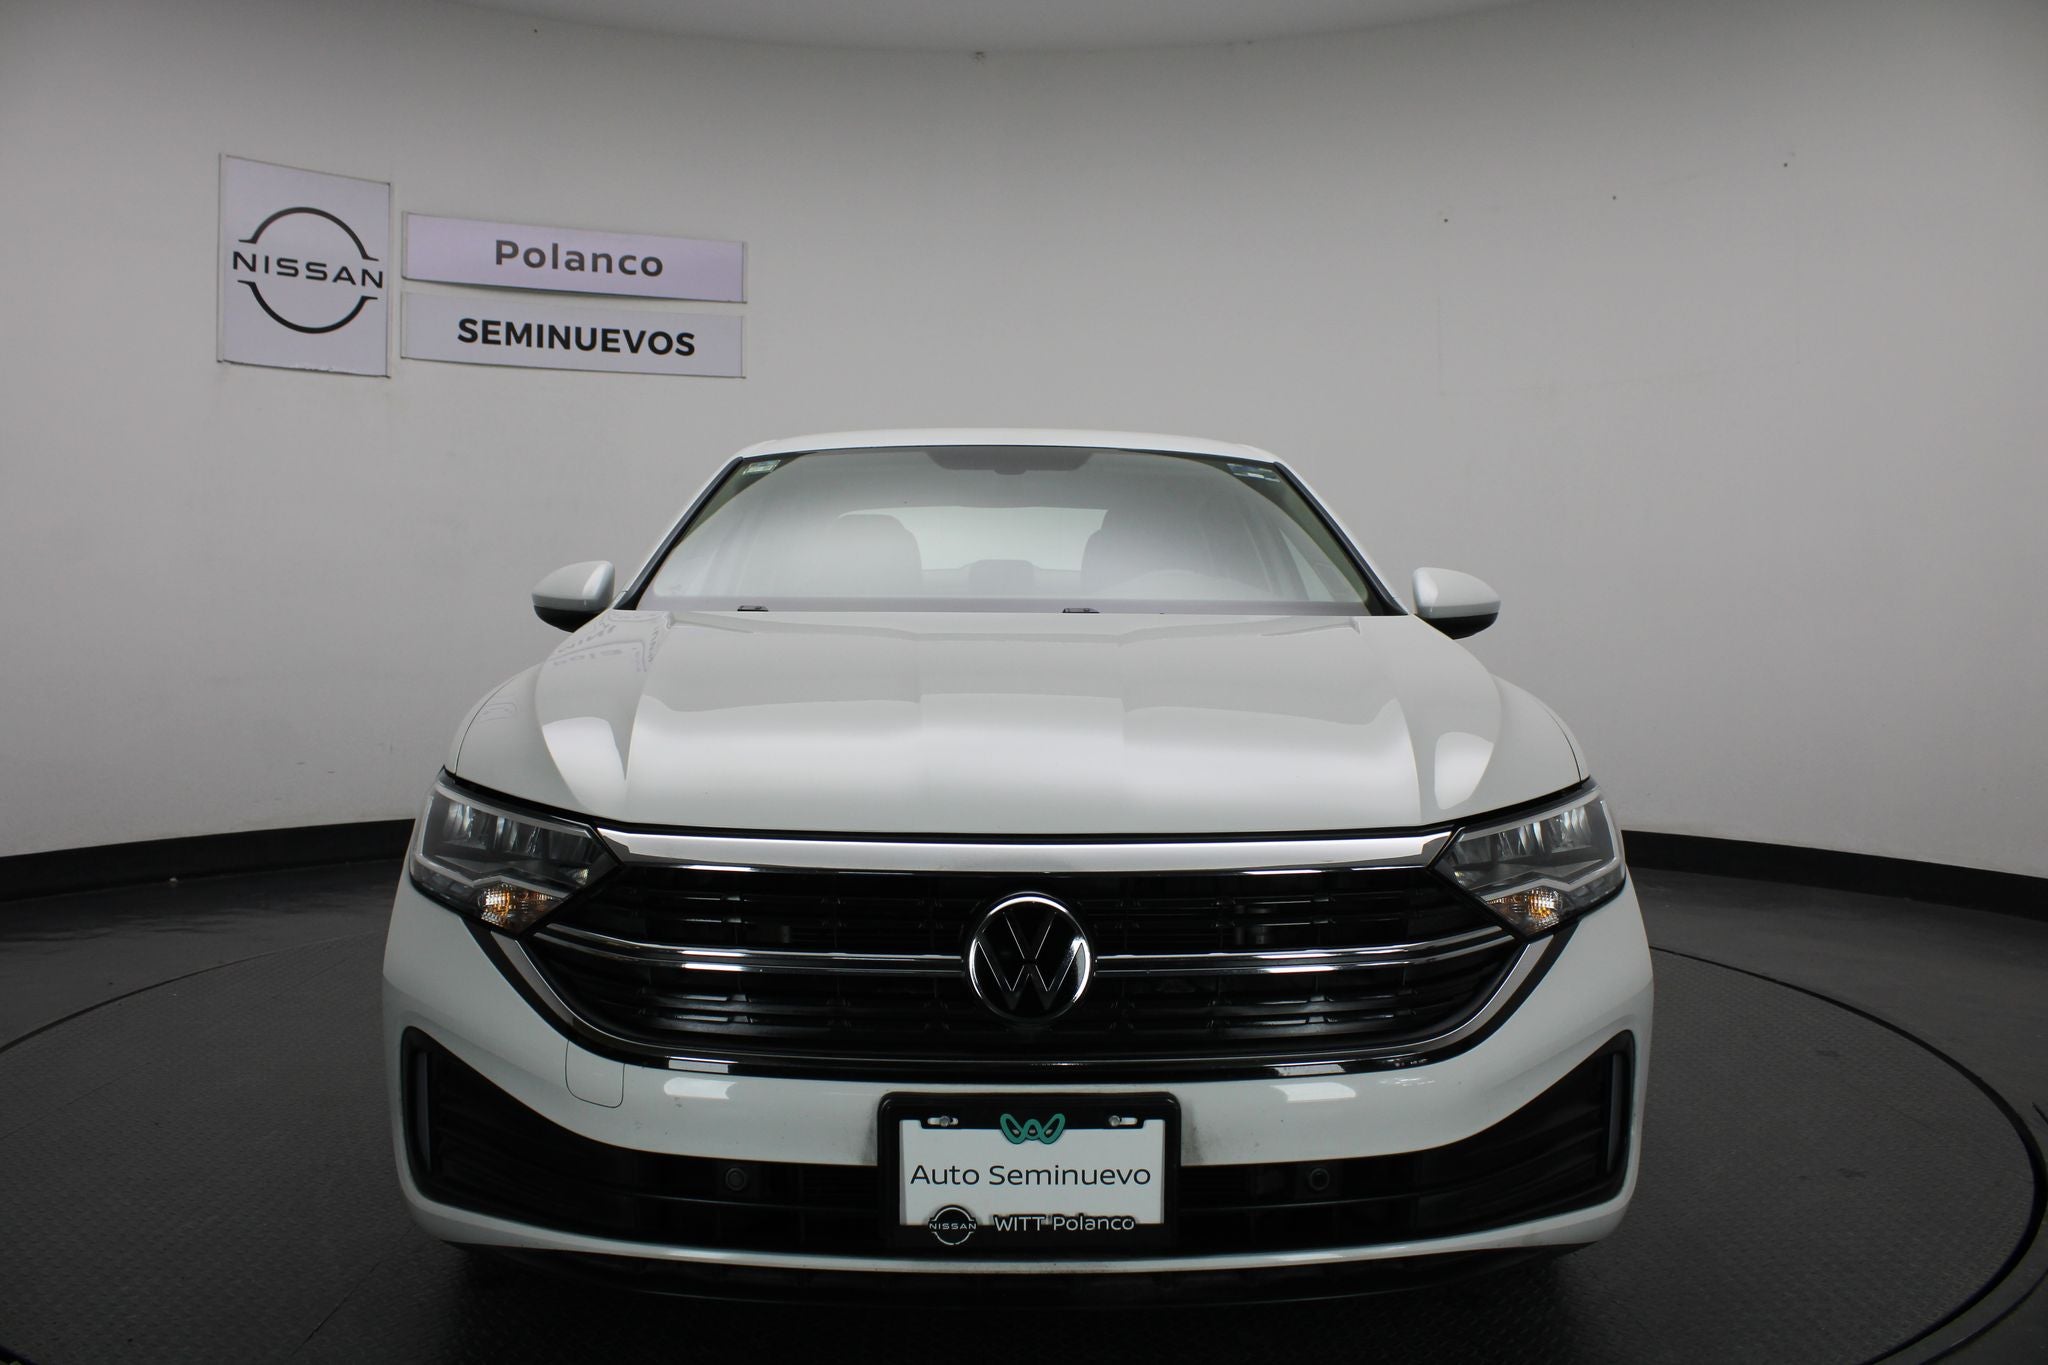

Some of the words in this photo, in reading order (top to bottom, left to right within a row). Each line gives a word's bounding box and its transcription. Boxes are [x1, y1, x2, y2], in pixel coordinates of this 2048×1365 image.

[232, 250, 384, 289] NISSAN
[494, 239, 664, 277] Polanco
[457, 317, 696, 356] SEMINUEVOS
[910, 1164, 980, 1185] Auto
[988, 1165, 1151, 1186] Seminuevo
[929, 1221, 977, 1231] NISSAN
[993, 1215, 1045, 1232] WITT
[1053, 1213, 1135, 1232] Polanco
